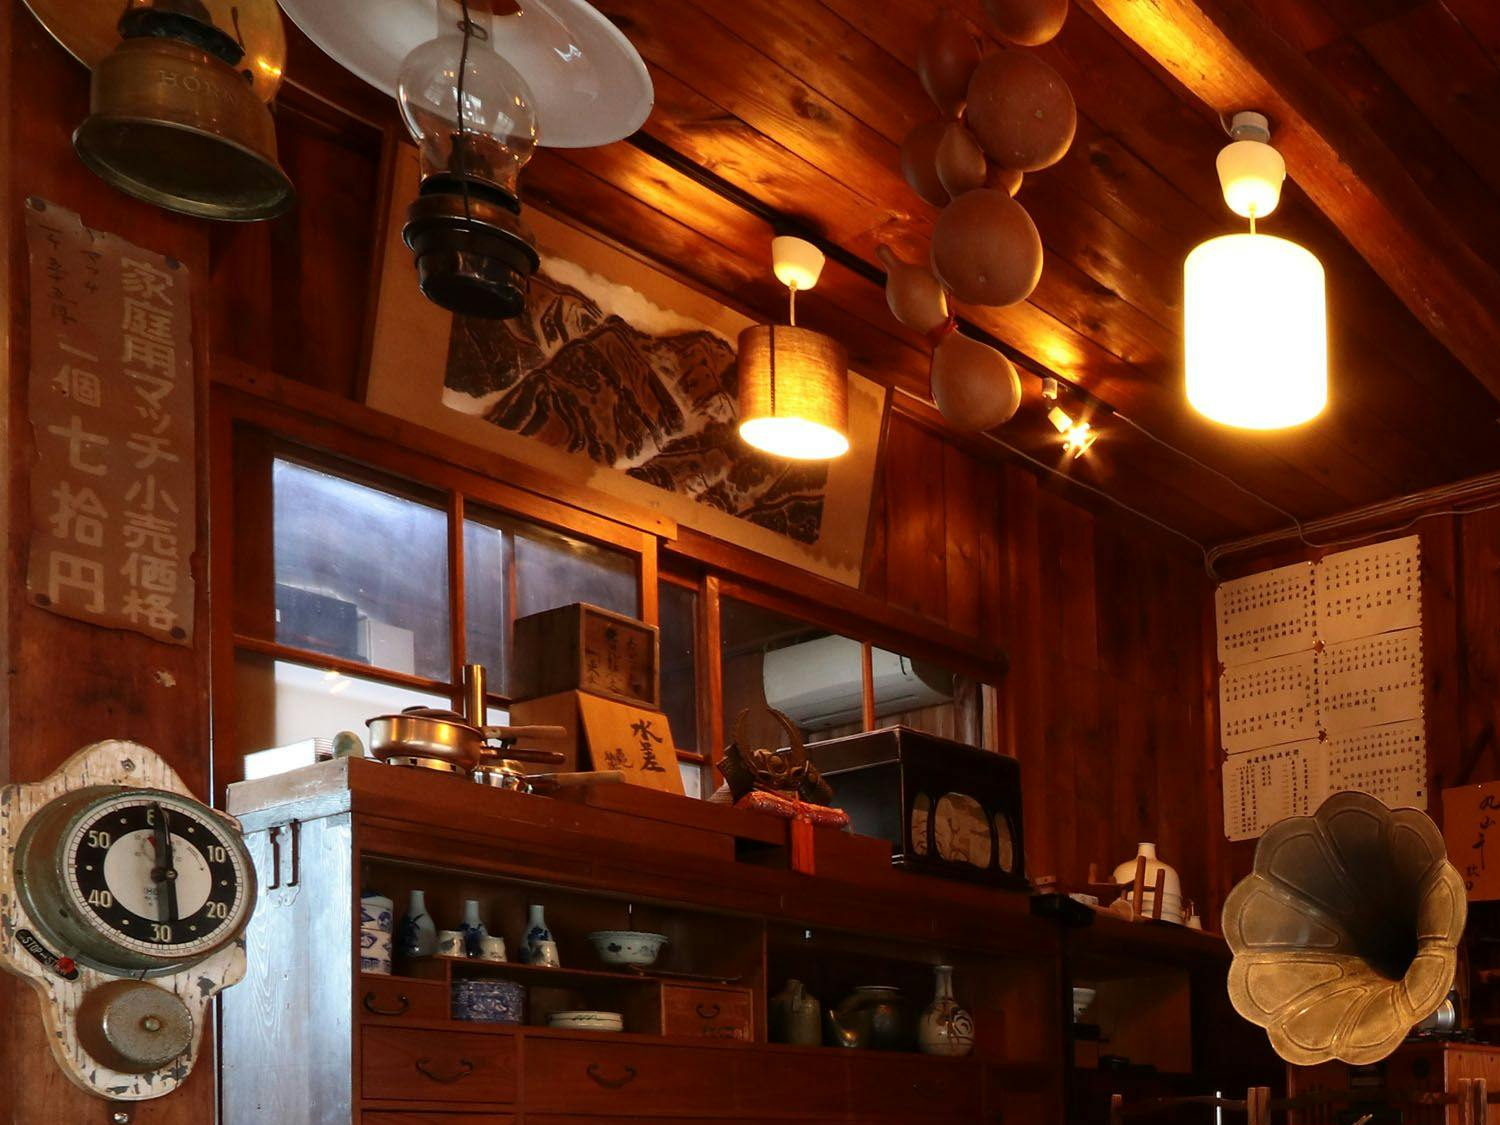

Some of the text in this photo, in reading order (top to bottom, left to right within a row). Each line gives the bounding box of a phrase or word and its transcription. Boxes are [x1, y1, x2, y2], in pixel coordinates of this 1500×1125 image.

[120, 254, 178, 632] 家庭用マッチ小売価格
[48, 336, 108, 616] 一個七拾円
[87, 830, 111, 849] 50
[207, 845, 226, 863] 10
[88, 889, 113, 908] 40
[205, 901, 228, 919] 20
[150, 923, 172, 943] 30
[22, 936, 43, 953] STOP
